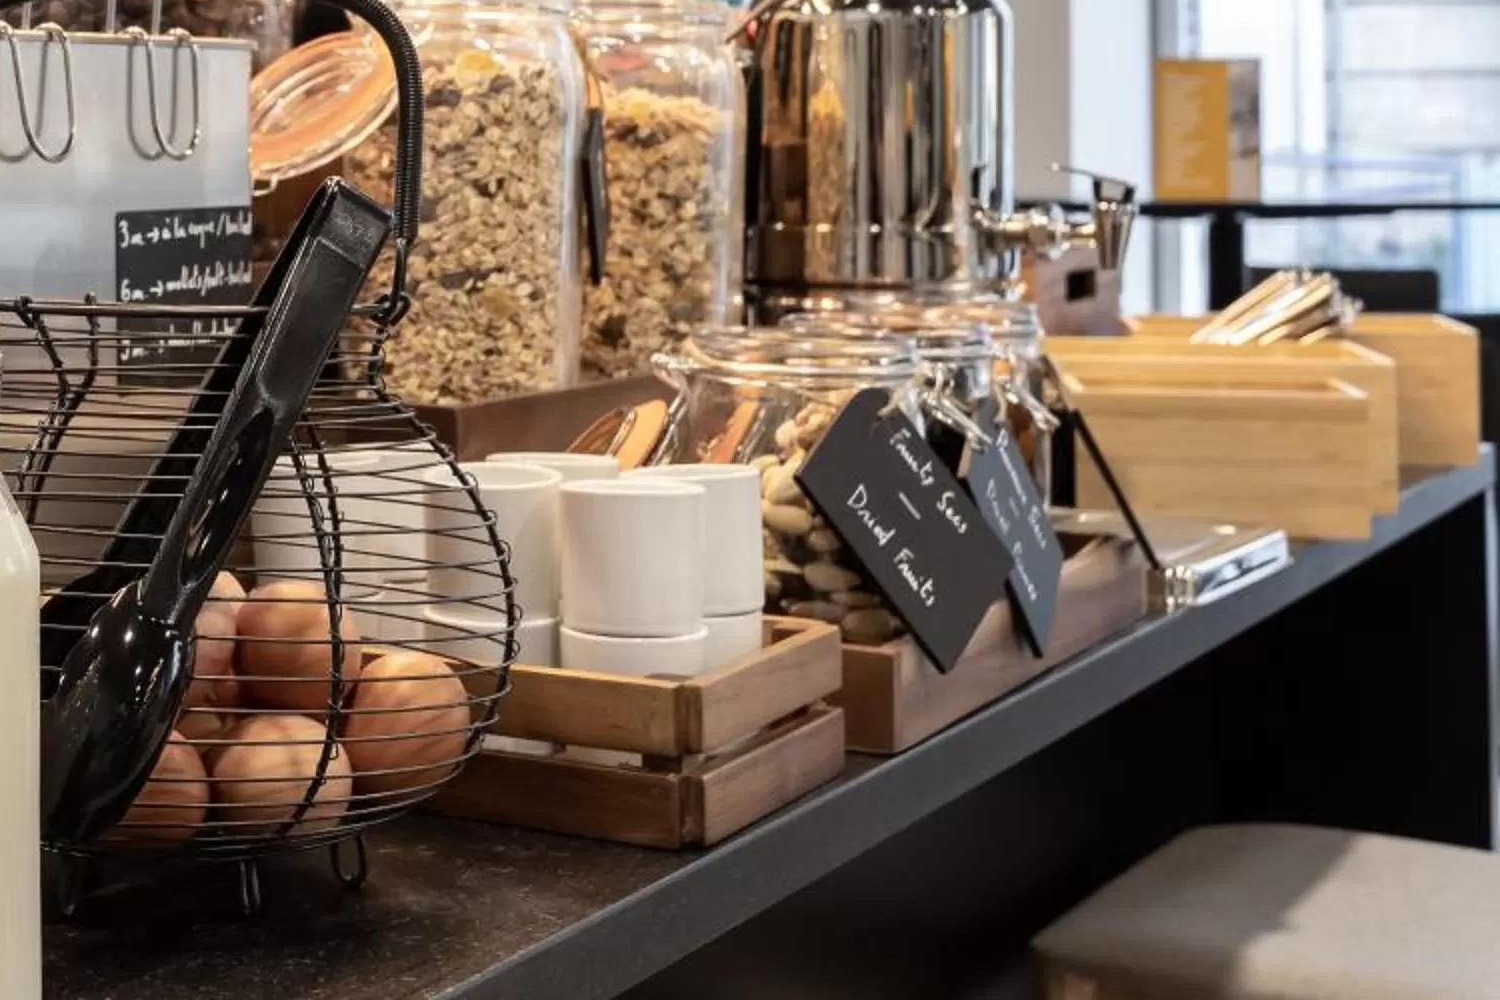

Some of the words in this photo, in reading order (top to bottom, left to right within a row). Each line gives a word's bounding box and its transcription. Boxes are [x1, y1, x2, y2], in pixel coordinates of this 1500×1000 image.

[889, 428, 935, 487] Fruits
[936, 491, 968, 534] Secs
[846, 483, 897, 547] Dried
[892, 547, 936, 607] Fruits
